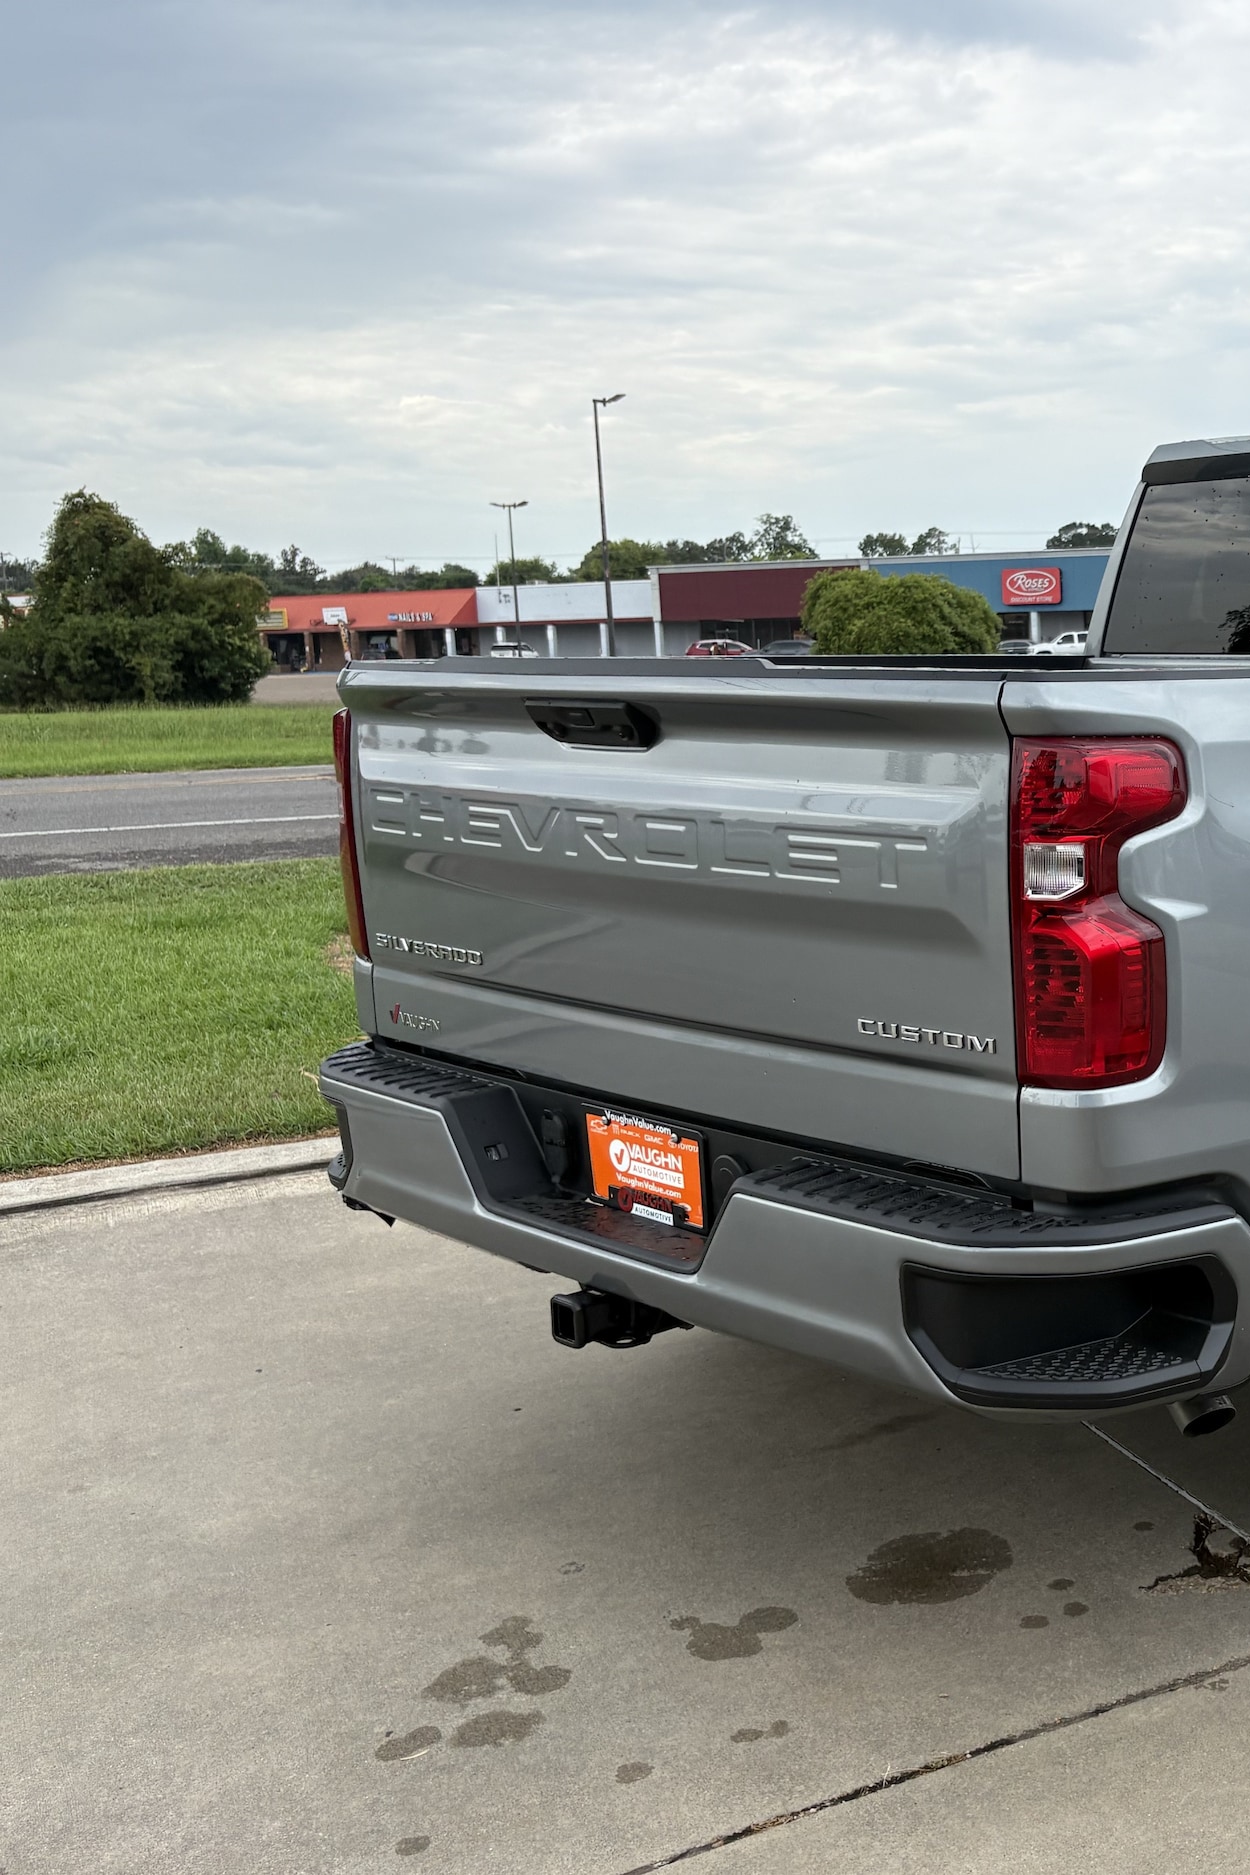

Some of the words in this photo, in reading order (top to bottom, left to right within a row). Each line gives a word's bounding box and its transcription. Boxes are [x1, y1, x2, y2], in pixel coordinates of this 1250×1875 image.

[1013, 574, 1050, 591] ROSES
[369, 787, 929, 889] CHEVROLET
[376, 933, 484, 965] SILVERADO
[857, 1018, 997, 1054] CUSTOM
[604, 1109, 672, 1136] VaughnValue.com
[644, 1134, 664, 1145] GMC
[626, 1142, 683, 1172] VAUGHN
[616, 1172, 682, 1199] VaughnValue.com
[633, 1165, 682, 1185] AUTOMOTIVE
[634, 1207, 673, 1222] AUTOMOTIVE
